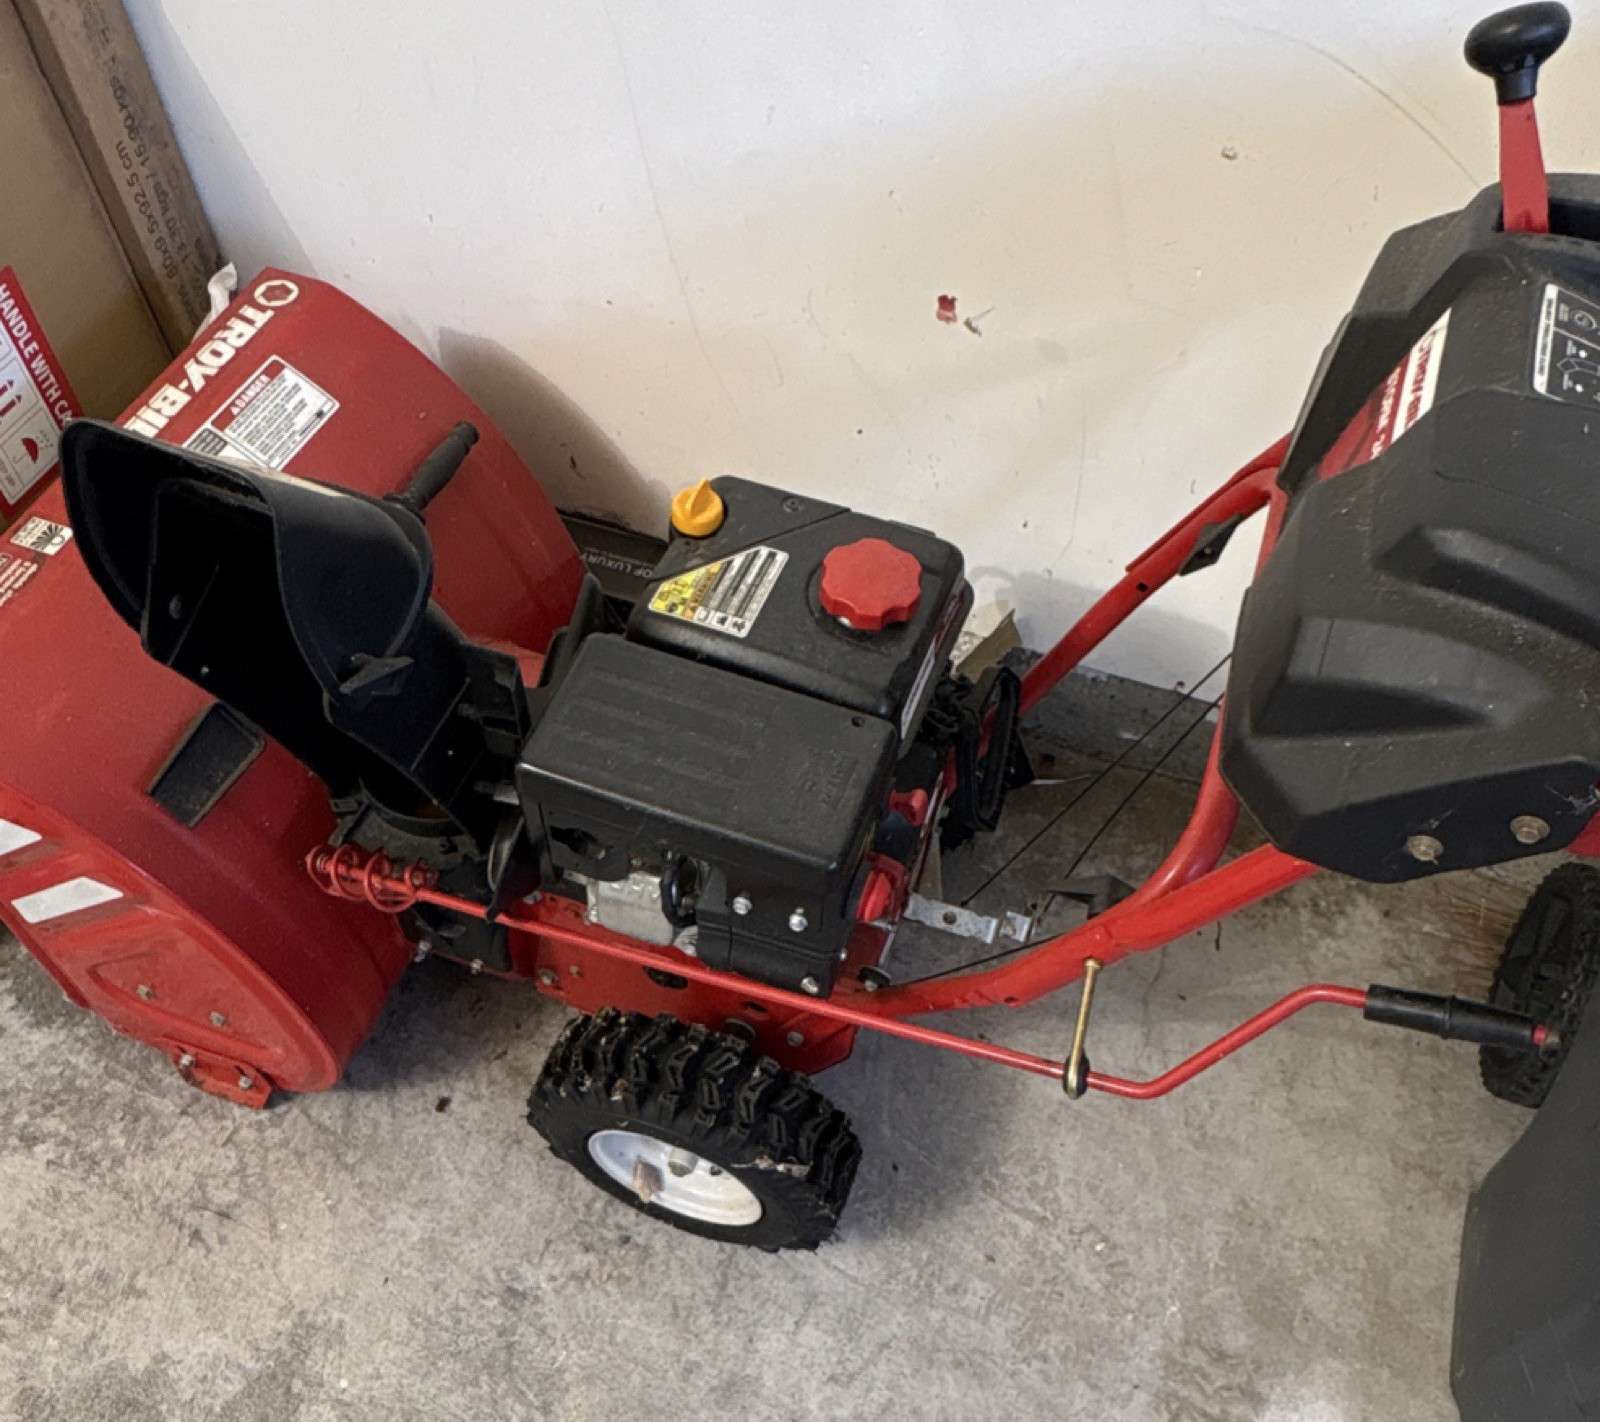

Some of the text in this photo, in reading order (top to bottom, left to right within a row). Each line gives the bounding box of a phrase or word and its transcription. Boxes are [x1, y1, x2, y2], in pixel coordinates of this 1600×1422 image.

[115, 141, 133, 170] cm
[0, 283, 39, 359] HANDLE
[31, 353, 62, 402] WITH
